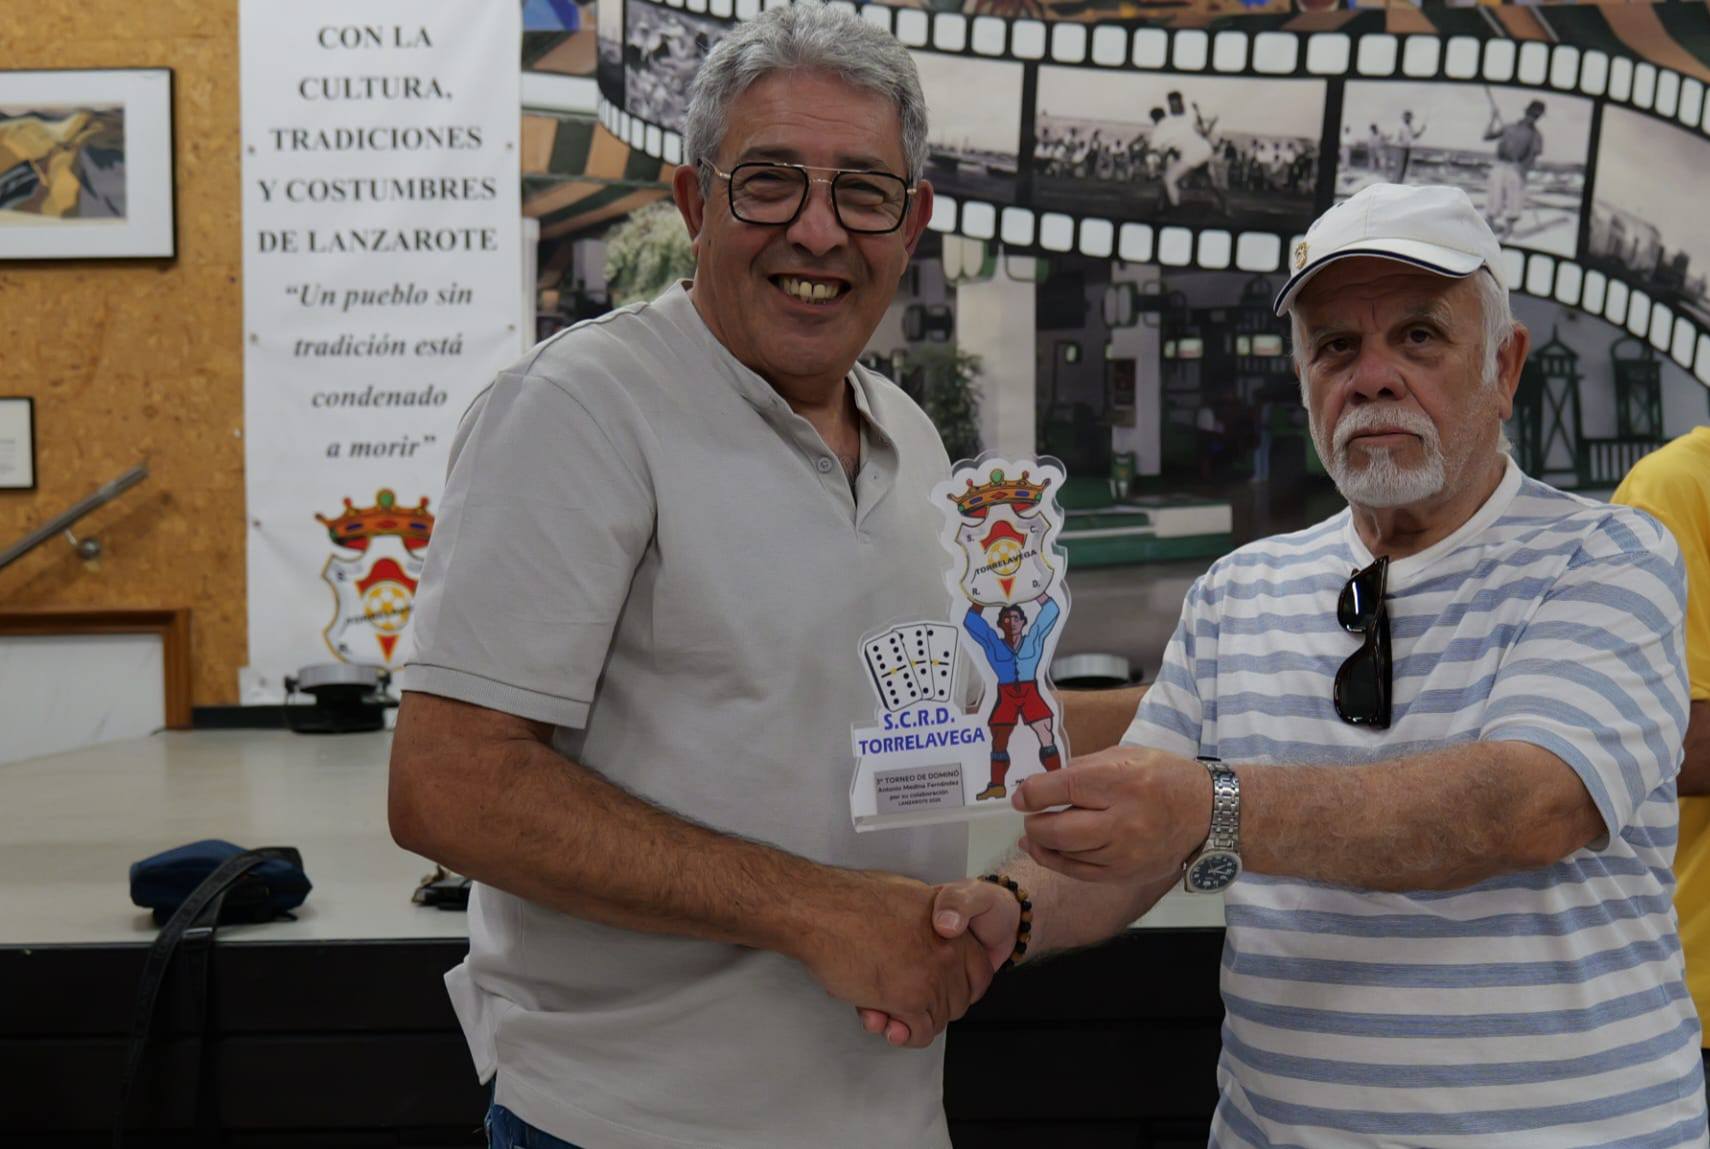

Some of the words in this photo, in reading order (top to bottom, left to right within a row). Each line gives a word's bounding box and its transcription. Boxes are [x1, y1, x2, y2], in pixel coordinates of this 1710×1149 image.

[318, 25, 383, 49] CON
[393, 25, 433, 48] LA
[270, 126, 483, 151] TRADICIONES
[257, 179, 276, 202] Y
[286, 177, 497, 202] COSTUMBRES
[258, 230, 297, 253] DE
[308, 228, 498, 252] LANZAROTE
[342, 282, 428, 313] pueblo
[437, 282, 473, 305] sin
[293, 333, 405, 357] tradición
[414, 332, 463, 357] está
[311, 384, 447, 408] condenado
[325, 442, 341, 459] a
[975, 549, 1038, 576] TORRELAVEGA
[884, 707, 955, 731] S.C.R.D.
[859, 727, 985, 755] TORRELAVEGA
[884, 775, 916, 784] TORNEO
[928, 769, 960, 779] DOMINÓ
